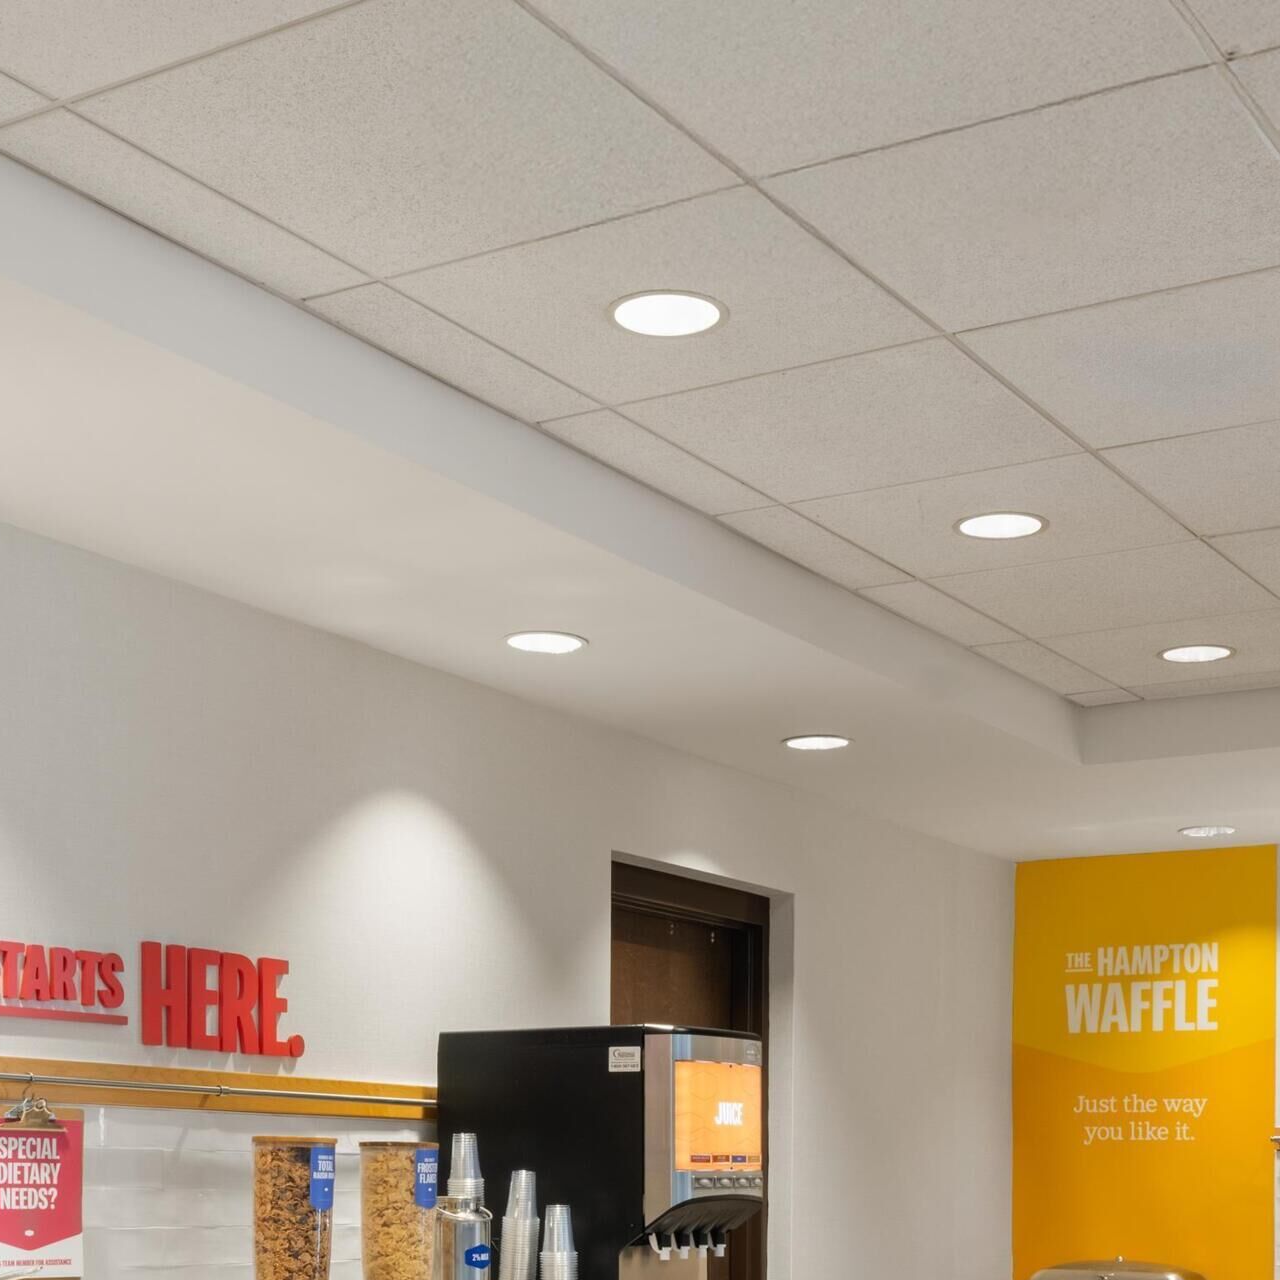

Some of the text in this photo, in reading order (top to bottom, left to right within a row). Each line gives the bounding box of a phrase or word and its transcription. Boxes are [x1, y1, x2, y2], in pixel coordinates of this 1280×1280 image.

[1065, 942, 1219, 977] THE HAMPTON
[141, 941, 305, 1058] HERE.
[1064, 978, 1219, 1034] WAFFLE
[714, 1102, 744, 1125] JUICE
[1073, 1094, 1208, 1118] Just the way
[1083, 1121, 1196, 1145] you like it.
[0, 1187, 58, 1210] NEEDS?
